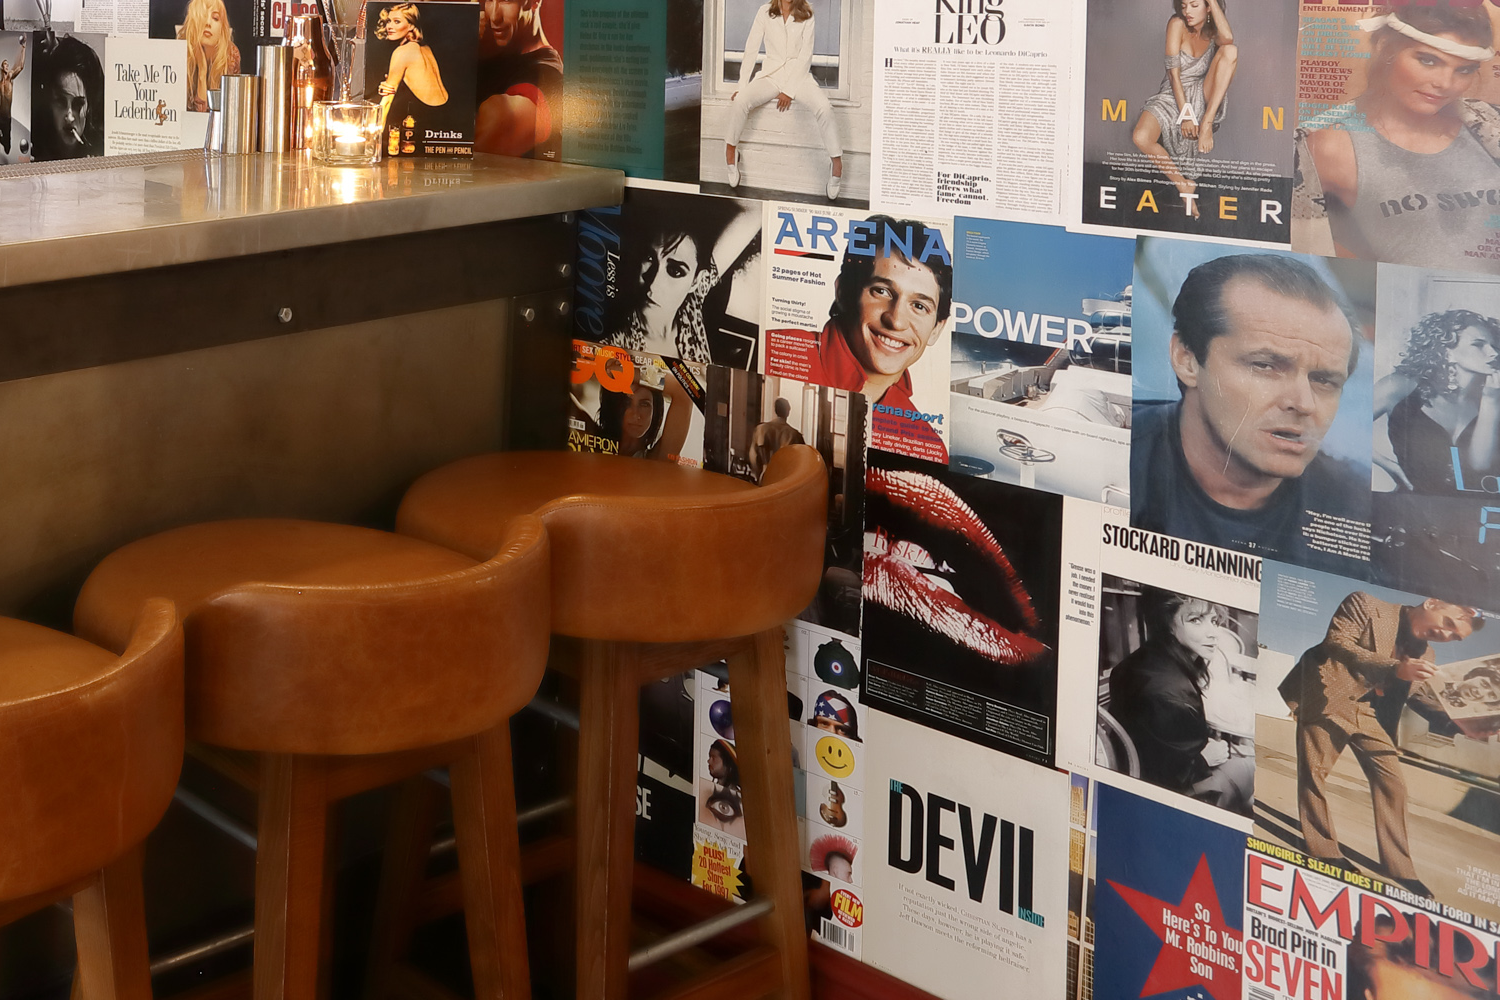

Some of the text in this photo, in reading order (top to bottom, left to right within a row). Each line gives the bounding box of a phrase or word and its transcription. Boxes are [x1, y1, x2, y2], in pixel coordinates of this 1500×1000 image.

[934, 14, 1006, 46] LEO
[114, 63, 177, 84] Take Me To
[133, 82, 158, 101] Your
[114, 100, 177, 123] Lederhoen
[424, 129, 463, 139] Drinks
[424, 146, 435, 154] THE
[435, 146, 446, 154] PEN
[453, 146, 473, 155] PENCIL
[774, 212, 951, 266] ARENA
[772, 273, 826, 287] Summer Fashion
[950, 301, 1093, 354] POWER
[872, 402, 944, 425] renasport
[1102, 523, 1180, 561] STOCKARD
[888, 780, 1045, 928] DEVIL
[1247, 837, 1472, 924] SHOWGIRLS: SLEAZY DOES HARRISON FORD
[834, 894, 863, 924] FILM
[1194, 902, 1211, 923] So
[1248, 853, 1500, 992] EMPIR
[1162, 908, 1243, 955] Here's To You
[1251, 915, 1337, 969] Brad Pitt in
[1165, 931, 1239, 974] Mr. Robbins,
[1190, 958, 1213, 980] Son
[1245, 940, 1342, 1000] SEVEN
